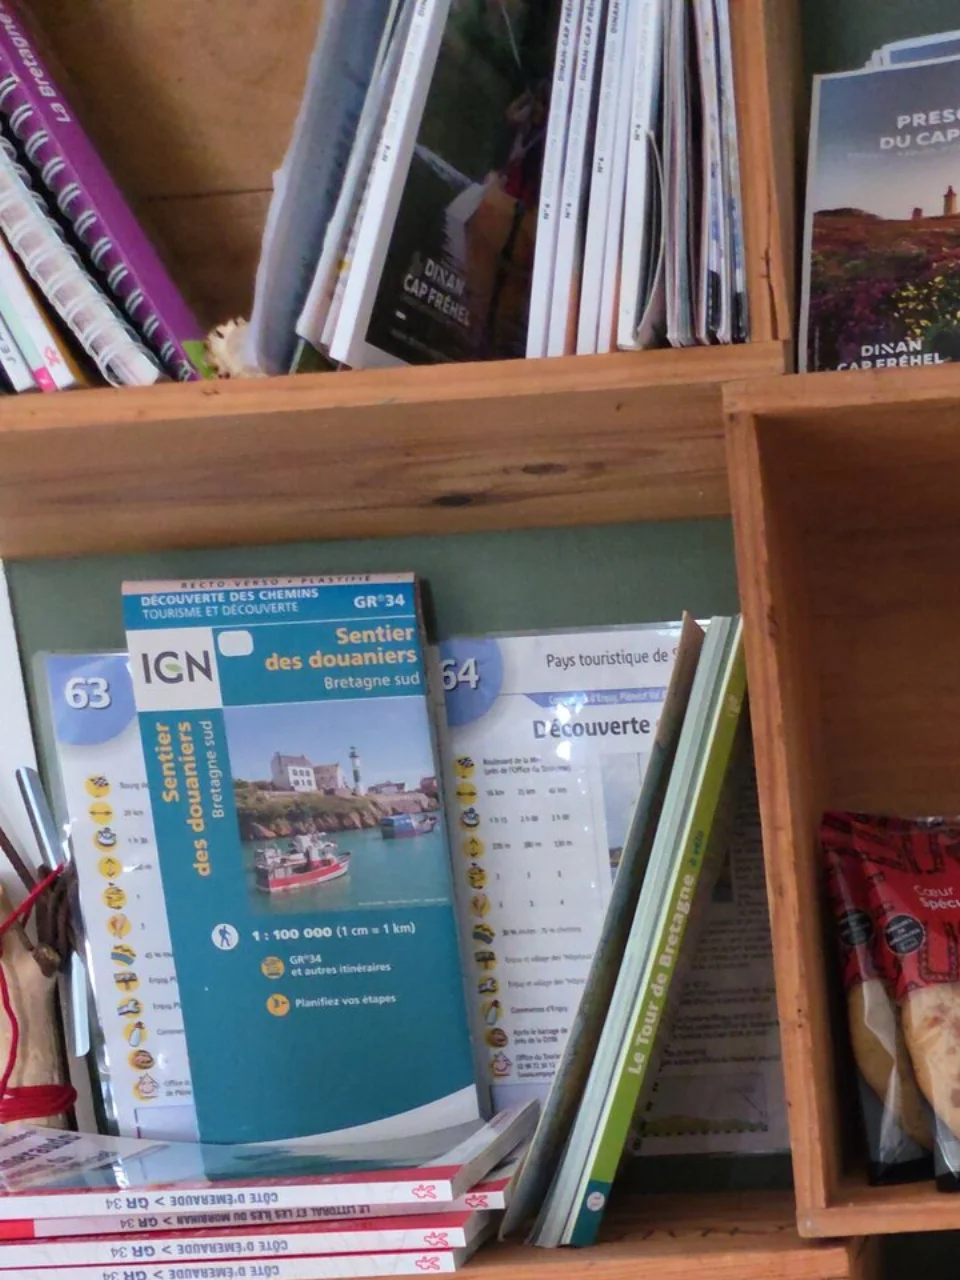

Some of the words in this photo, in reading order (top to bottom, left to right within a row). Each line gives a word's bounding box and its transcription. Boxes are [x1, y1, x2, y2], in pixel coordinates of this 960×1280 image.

[0, 12, 57, 97] Bretagne
[50, 102, 71, 122] La
[880, 133, 911, 151] DU
[916, 128, 960, 148] CAP
[425, 258, 466, 296] DINAN
[404, 273, 428, 298] CAP
[428, 287, 470, 327] FRÉHEL
[861, 338, 923, 357] DINAN
[875, 352, 944, 369] FRÉHEL
[140, 592, 225, 607] DÉCOUVERTE
[230, 590, 255, 602] DES
[259, 587, 320, 601] CHEMINS
[142, 608, 202, 620] TOURISME
[206, 606, 219, 618] ET
[223, 602, 300, 617] DÉCOUVERTE
[335, 627, 415, 645] Sentier
[140, 650, 213, 685] IGN
[265, 652, 304, 672] des
[309, 648, 418, 669] douaniers
[546, 654, 576, 671] Pays
[579, 650, 649, 667] touristique
[652, 648, 668, 662] de
[324, 675, 391, 691] Bretagne
[394, 673, 421, 686] sud
[441, 657, 480, 692] 64
[65, 676, 112, 710] 63
[199, 720, 214, 748] sud
[533, 717, 651, 739] Découverte
[155, 722, 180, 803] Sentier
[176, 721, 205, 832] douaniers
[206, 750, 225, 819] Bretagne
[193, 839, 211, 877] des
[914, 885, 954, 897] Cœur
[658, 873, 695, 965] Bretagne
[252, 931, 260, 941] 1
[273, 928, 299, 940] 100
[303, 927, 333, 939] 000
[351, 927, 368, 936] cm
[392, 922, 416, 935] km)
[291, 967, 302, 977] et
[304, 965, 337, 976] autres
[339, 962, 392, 974] itinéraires
[650, 972, 667, 998] de
[295, 997, 340, 1008] Planifiez
[343, 996, 360, 1006] vos
[362, 994, 397, 1006] étapes
[636, 1002, 660, 1049] Tour
[628, 1053, 645, 1076] Le
[105, 1197, 123, 1211] 34
[126, 1196, 150, 1210] GR
[170, 1192, 246, 1207] D'ÉMERAUDE
[250, 1191, 279, 1205] CÔTE
[120, 1218, 136, 1229] 34
[138, 1216, 158, 1228] GR
[110, 1246, 128, 1259] 34
[131, 1244, 156, 1257] GR
[177, 1241, 255, 1255] D'ÉMERAUDE
[255, 1239, 289, 1252] CÔTE
[168, 1265, 246, 1280] D'ÉMERAUDE
[250, 1264, 280, 1277] CÔTE
